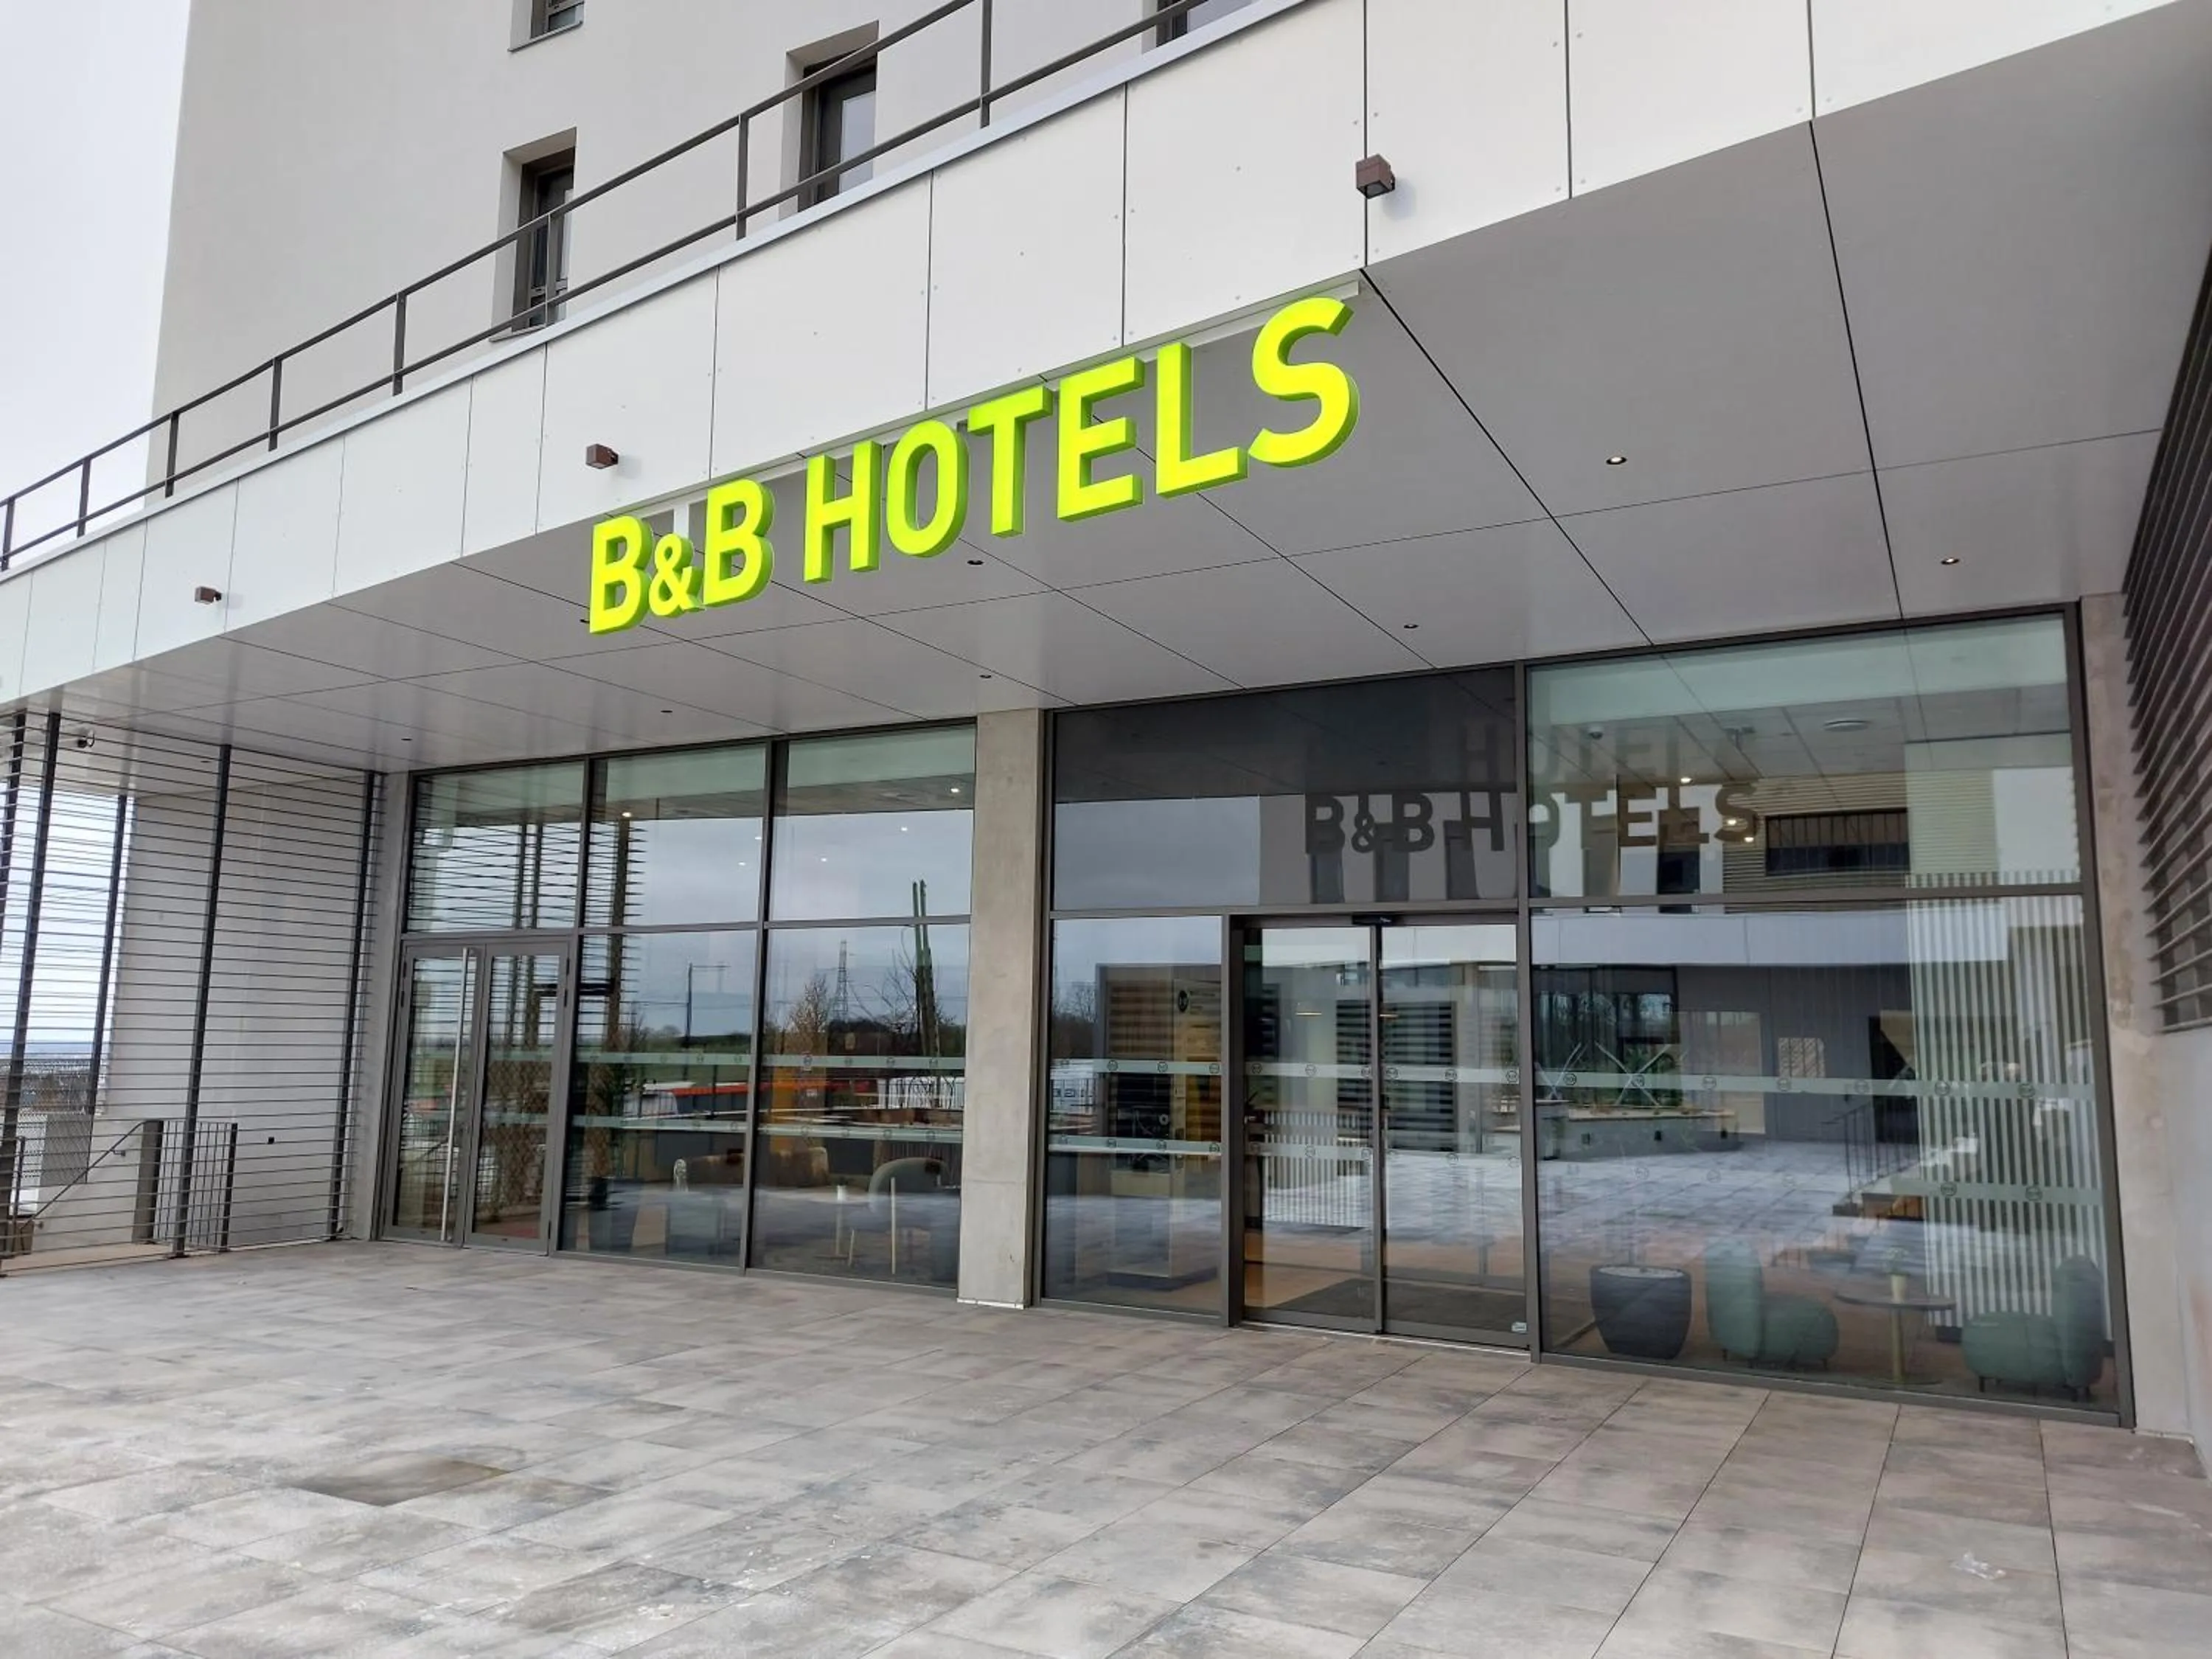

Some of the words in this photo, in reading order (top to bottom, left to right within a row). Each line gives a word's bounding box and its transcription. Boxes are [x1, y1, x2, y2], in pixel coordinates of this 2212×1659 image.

[588, 477, 773, 635] B&B
[804, 296, 1358, 583] HOTELS
[1306, 790, 1435, 854] B&B
[1459, 779, 1758, 851] HOTELS
